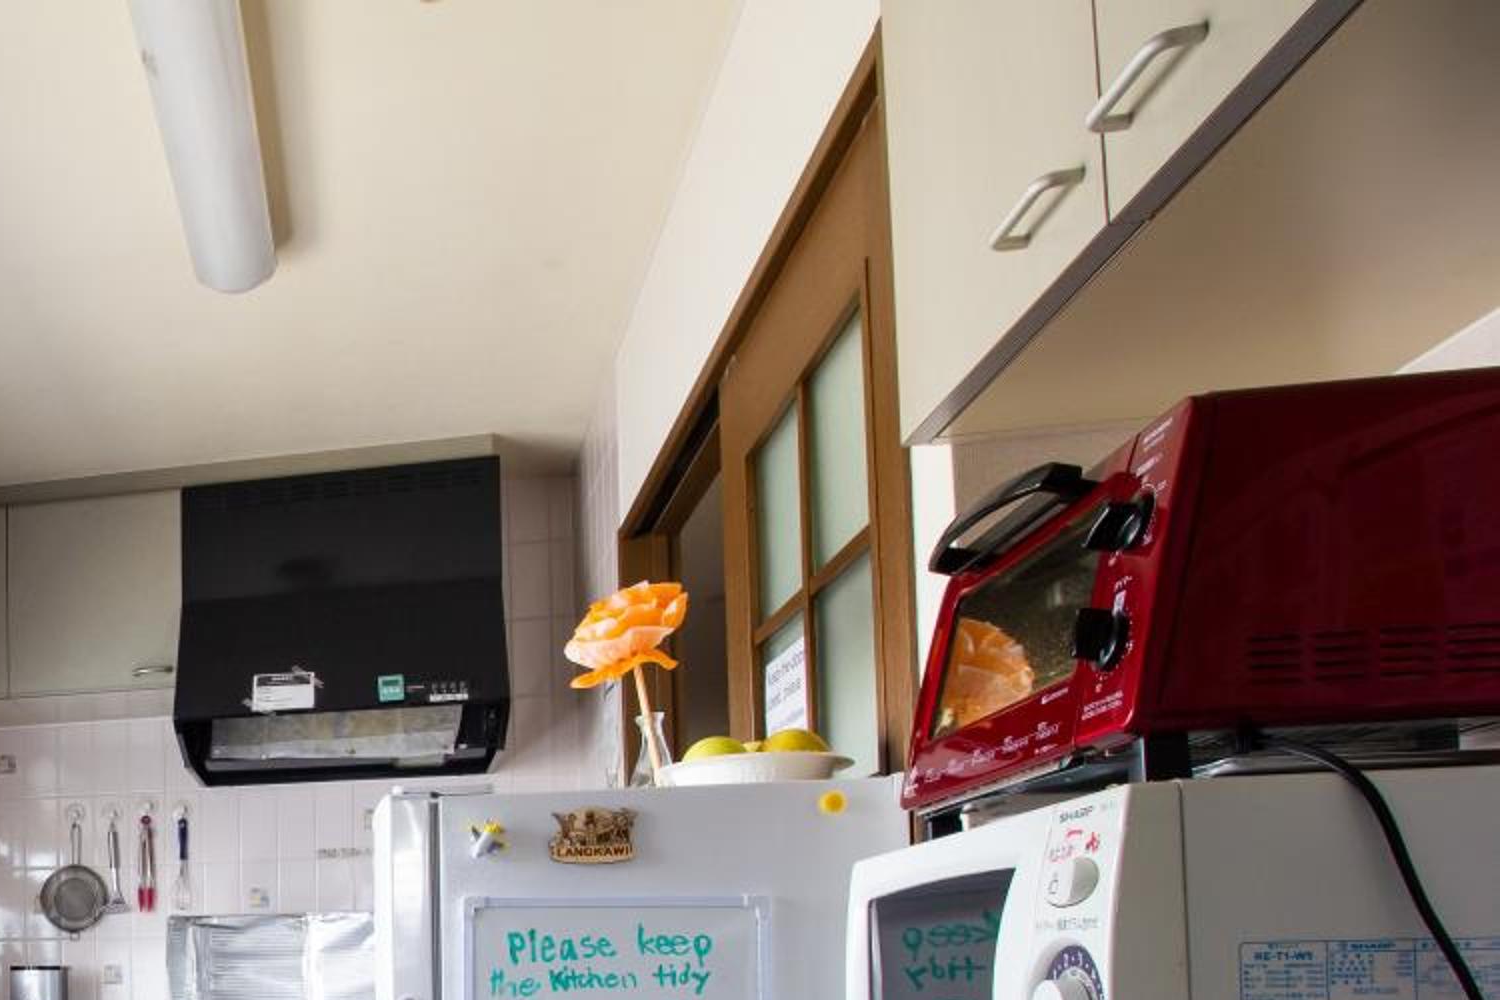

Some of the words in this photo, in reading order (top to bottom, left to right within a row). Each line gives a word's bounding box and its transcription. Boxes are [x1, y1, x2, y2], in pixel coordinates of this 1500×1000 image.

[1060, 805, 1093, 823] SHARP
[557, 847, 630, 857] LANGKAWI
[636, 923, 713, 967] keep
[653, 962, 711, 995] tidy
